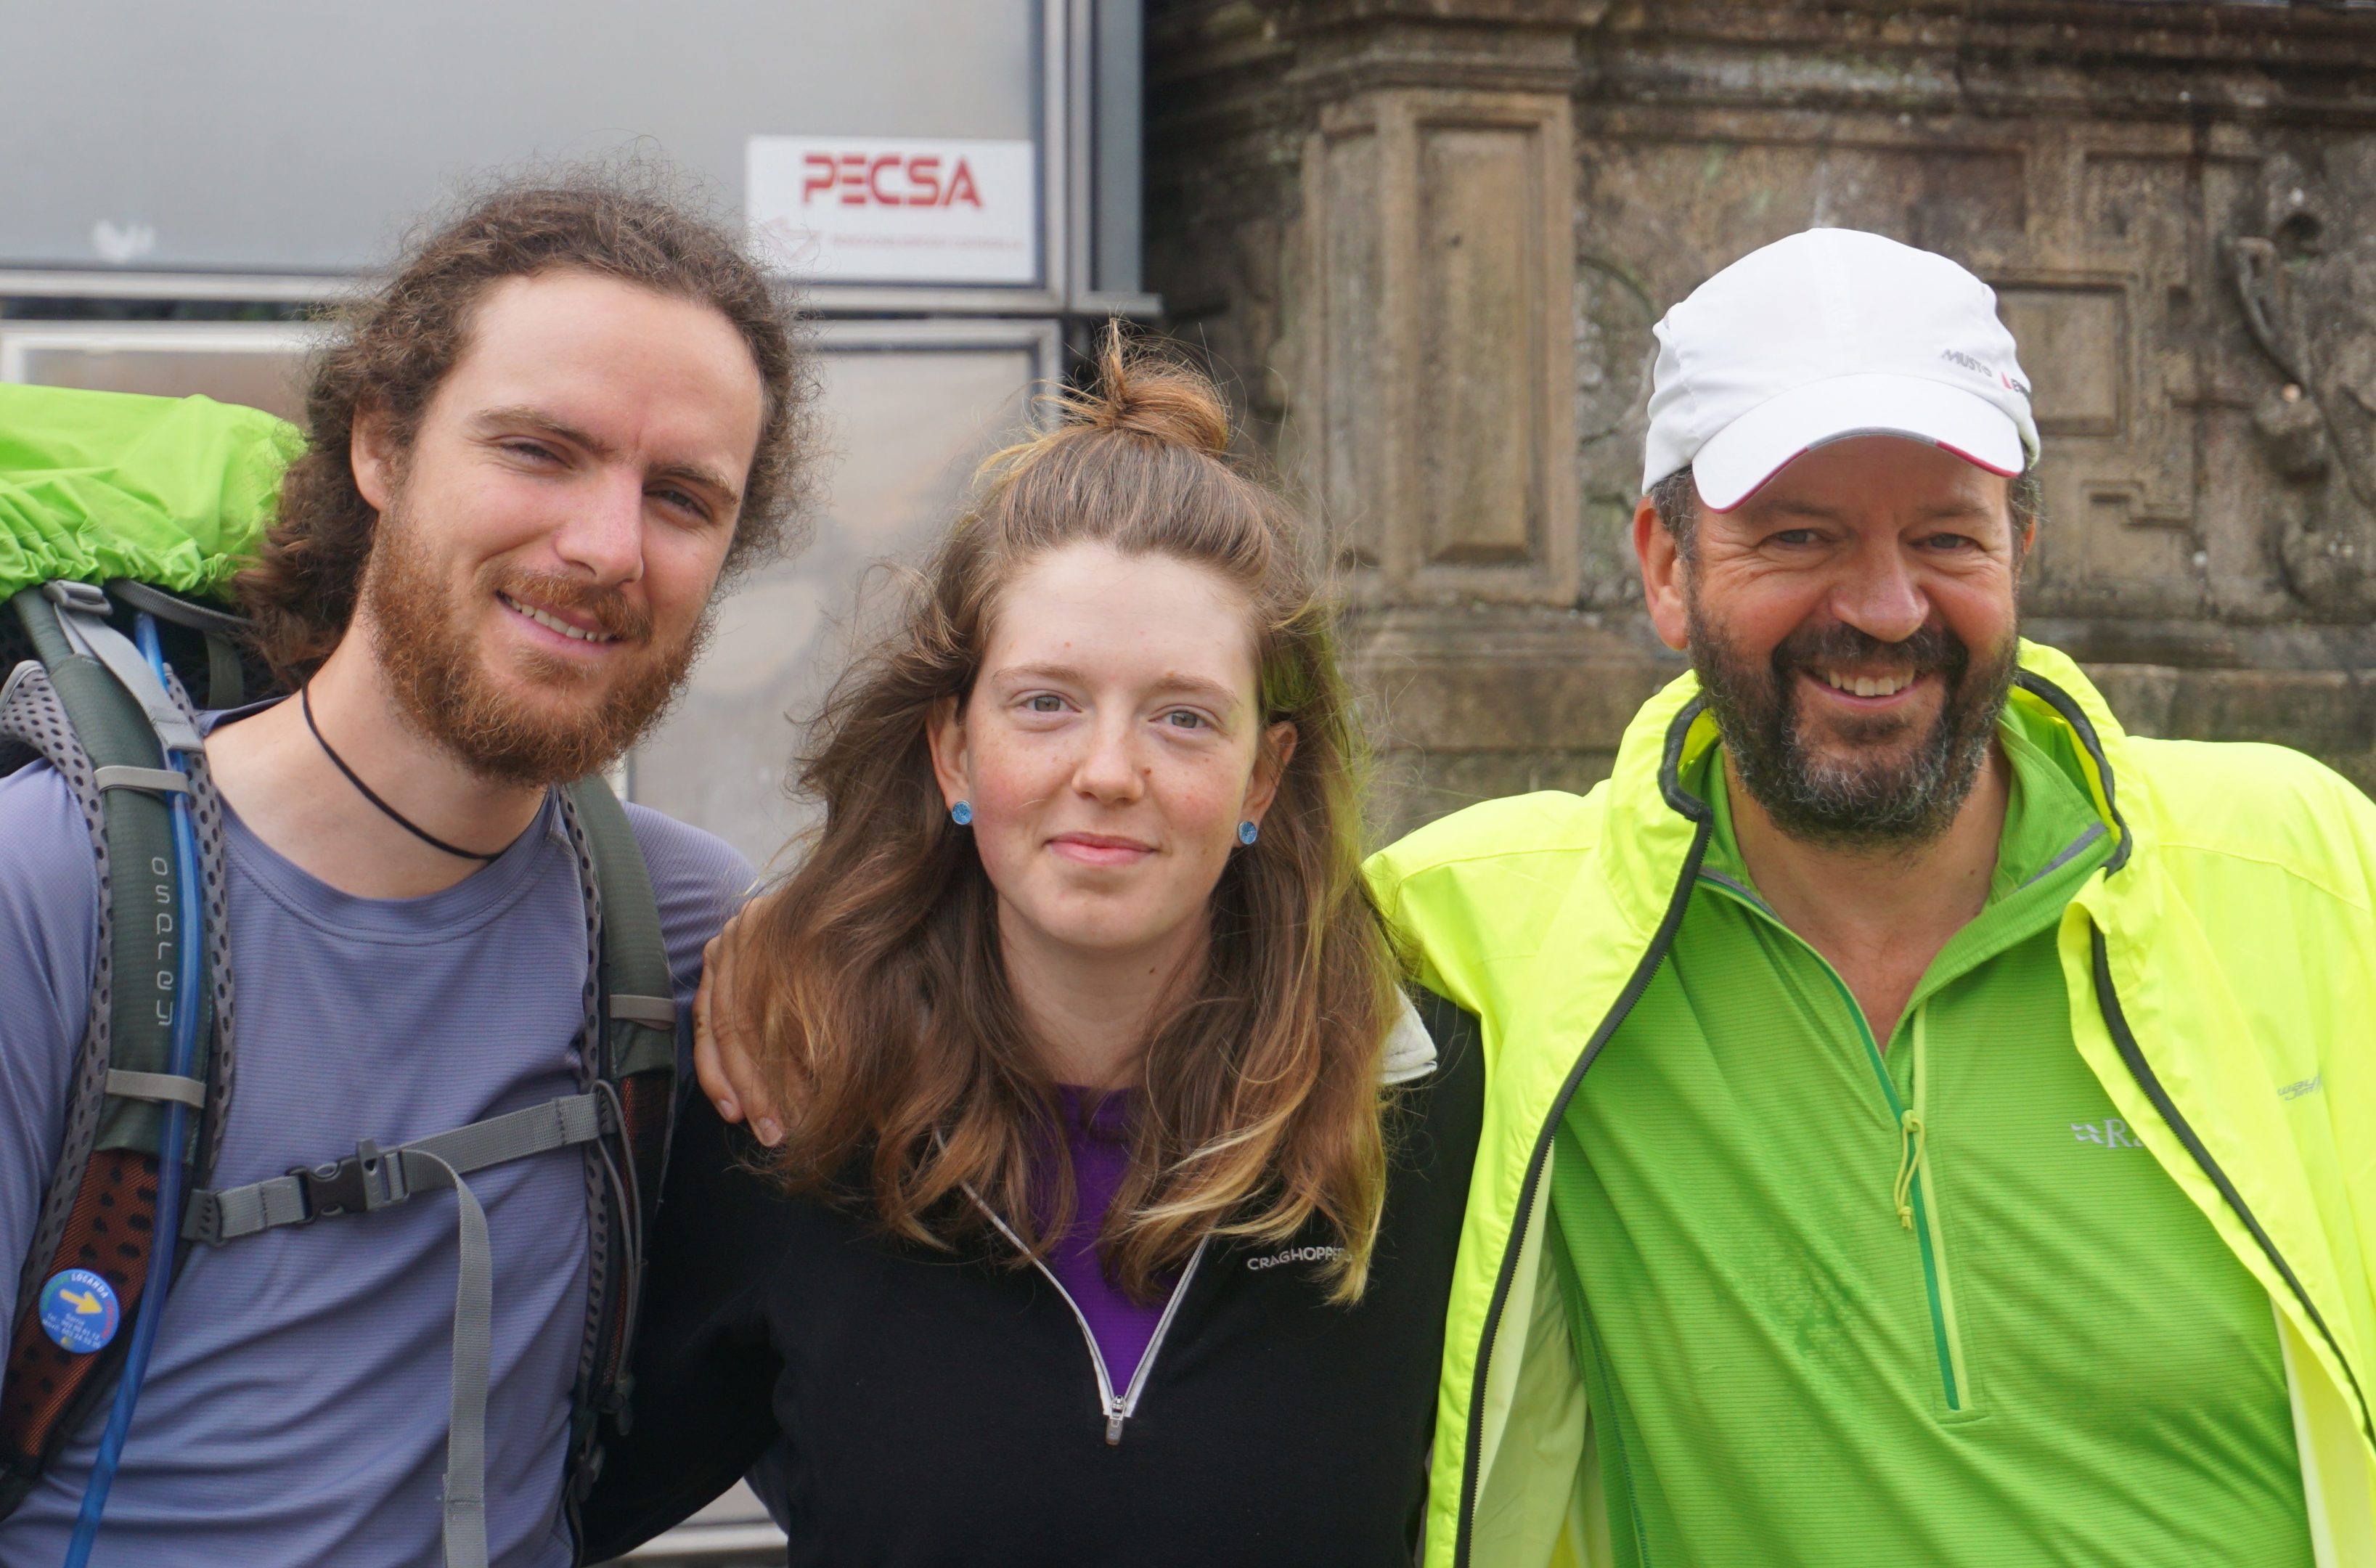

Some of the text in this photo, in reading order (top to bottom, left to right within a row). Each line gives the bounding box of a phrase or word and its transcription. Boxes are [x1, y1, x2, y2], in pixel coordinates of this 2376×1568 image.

[804, 154, 982, 208] PECSA
[1941, 348, 1992, 377] MUSTO
[151, 857, 173, 1026] osprey
